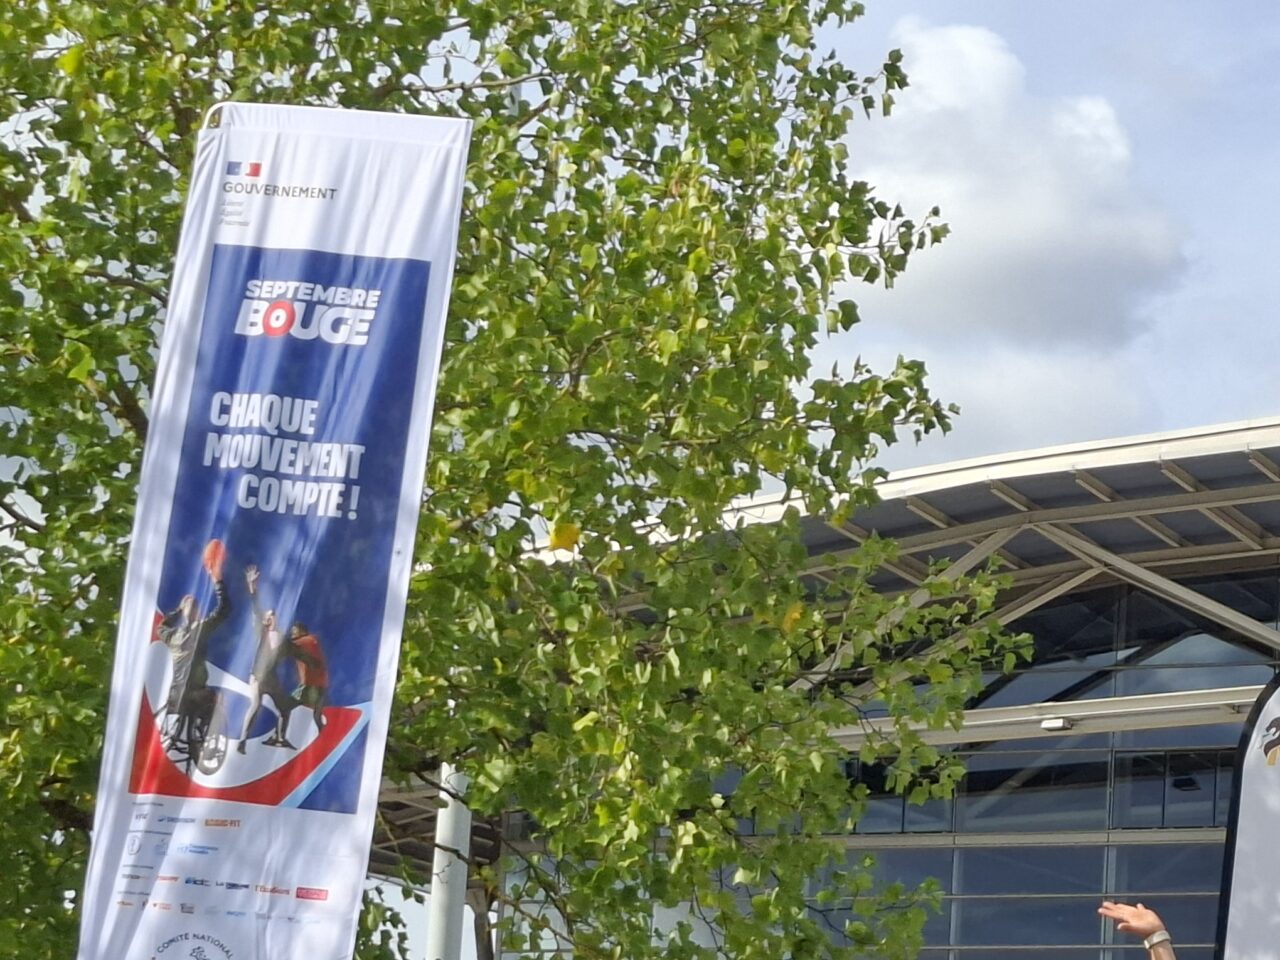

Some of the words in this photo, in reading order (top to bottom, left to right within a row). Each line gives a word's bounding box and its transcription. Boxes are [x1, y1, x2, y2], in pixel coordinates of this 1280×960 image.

[222, 181, 338, 200] GOUVERNEMENT
[245, 280, 382, 308] SEPTEMBRE
[234, 298, 376, 346] BOUGE
[209, 391, 319, 436] CHAQUE
[202, 432, 366, 480] MOUVEMENT
[192, 933, 234, 960] NATIONAL
